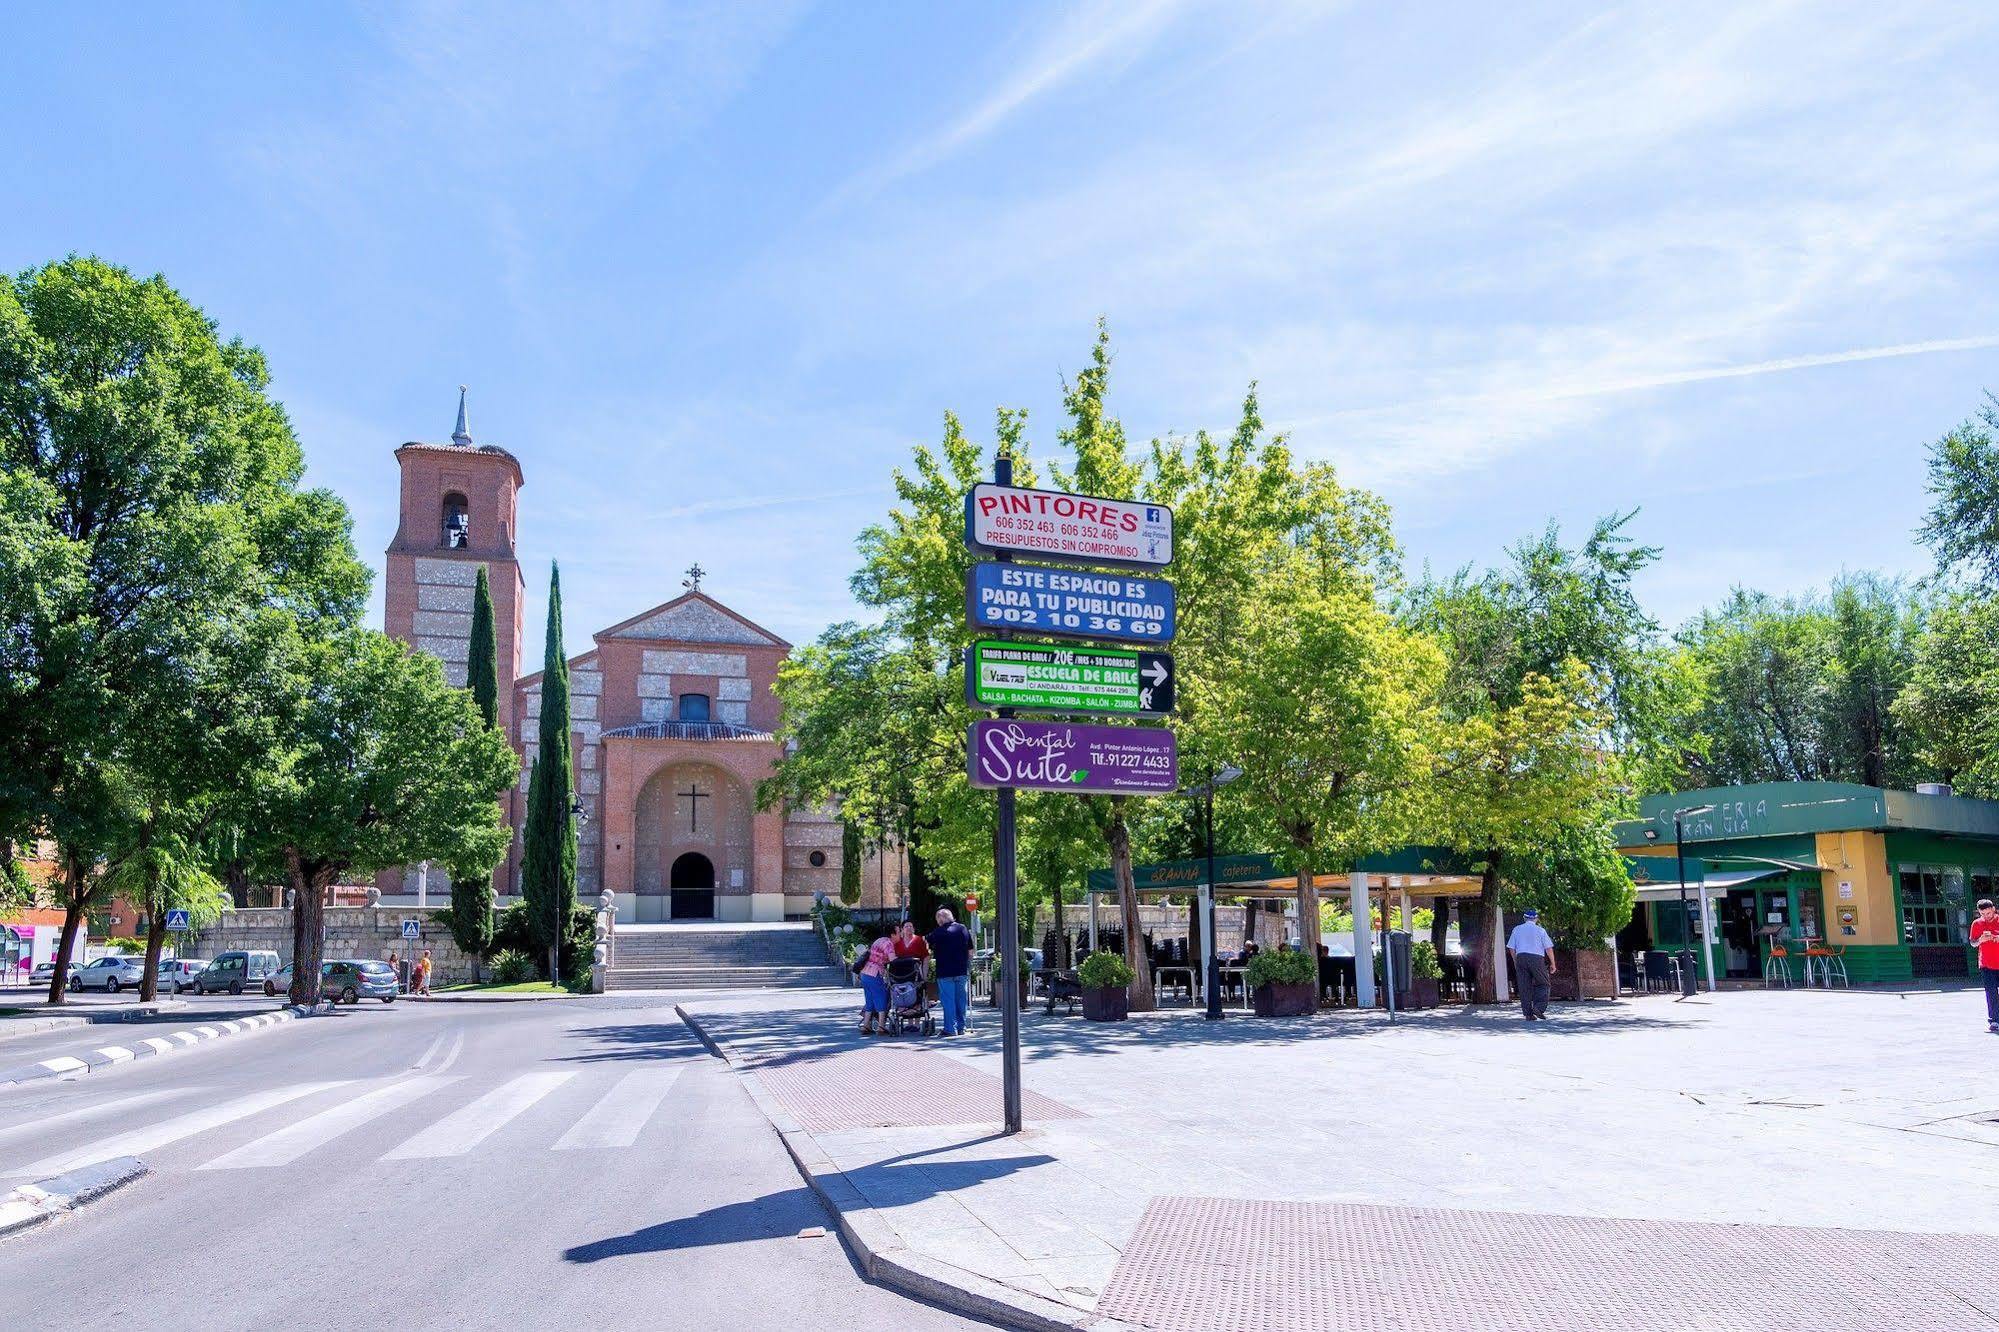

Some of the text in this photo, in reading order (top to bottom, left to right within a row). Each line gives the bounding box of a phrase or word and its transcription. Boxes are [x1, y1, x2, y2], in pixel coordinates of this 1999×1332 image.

[978, 494, 1138, 532] PINTORES
[996, 516, 1118, 541] 606 352 463 606 352 466
[987, 531, 1138, 558] PRESUPUESTOS SIN COMPROMISO
[1002, 569, 1146, 599] ESTE ESPACIO ES
[982, 587, 1166, 621] PARA TU PUBLICIDAD
[986, 606, 1162, 635] 902 10 36 69
[982, 649, 1002, 660] TARIFA
[1003, 650, 1022, 660] PLANA
[1022, 651, 1031, 661] DE
[1031, 652, 1048, 662] BAILE
[1053, 649, 1074, 665] 20€
[1027, 665, 1139, 685] ESCUELA DE BAILE
[982, 692, 1006, 701] SALSA
[1011, 693, 1044, 703] BACHATA
[1049, 696, 1081, 705] KIZOMBA
[1086, 696, 1110, 707] SALÓN
[1114, 699, 1138, 709] ZUMBA
[1008, 724, 1076, 749] Dental
[1104, 743, 1121, 751] Pintor
[1122, 744, 1143, 752] Antonio
[982, 728, 1078, 783] Suite
[1142, 755, 1170, 769] 4433
[1222, 864, 1262, 880] cafeteria
